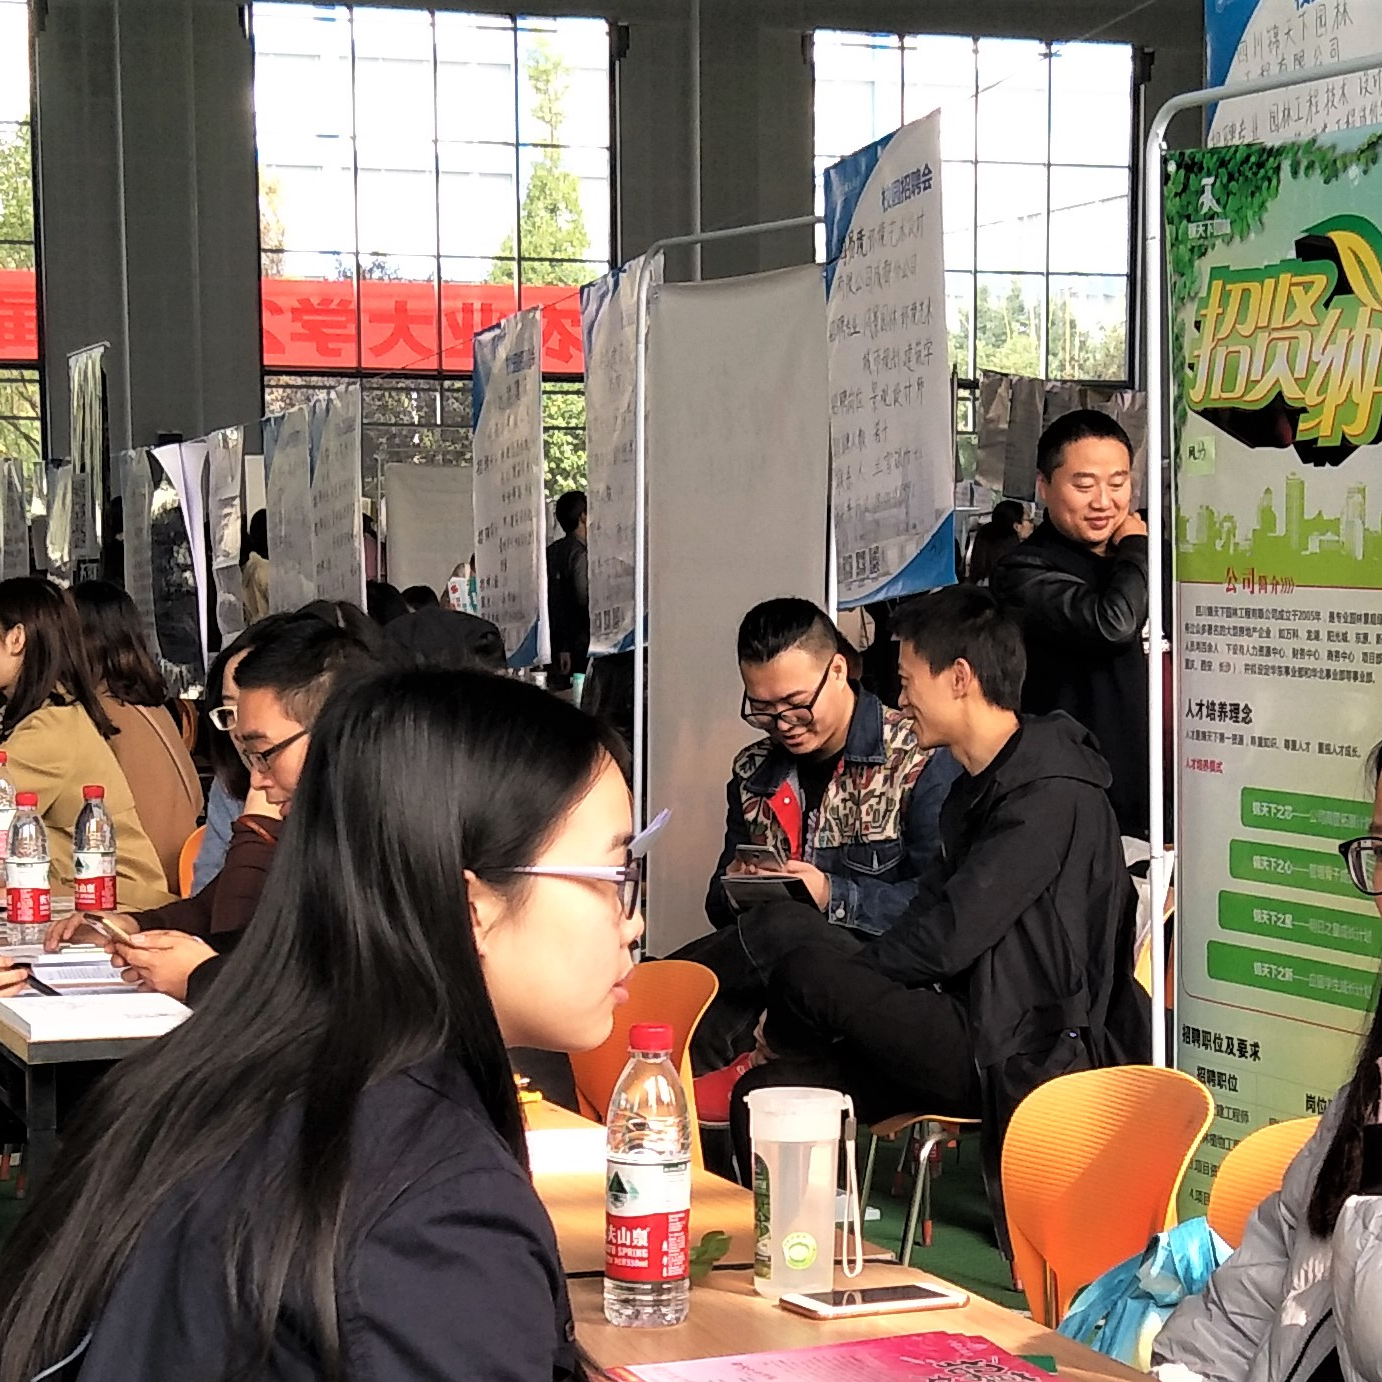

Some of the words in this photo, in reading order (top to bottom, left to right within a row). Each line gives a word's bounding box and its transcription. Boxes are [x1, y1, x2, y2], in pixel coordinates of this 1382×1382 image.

[1225, 566, 1280, 595] 公司简介
[1185, 698, 1253, 725] 人才培养理念
[1182, 1024, 1261, 1062] 招聘职位及要求
[1196, 1066, 1239, 1093] 招聘职位
